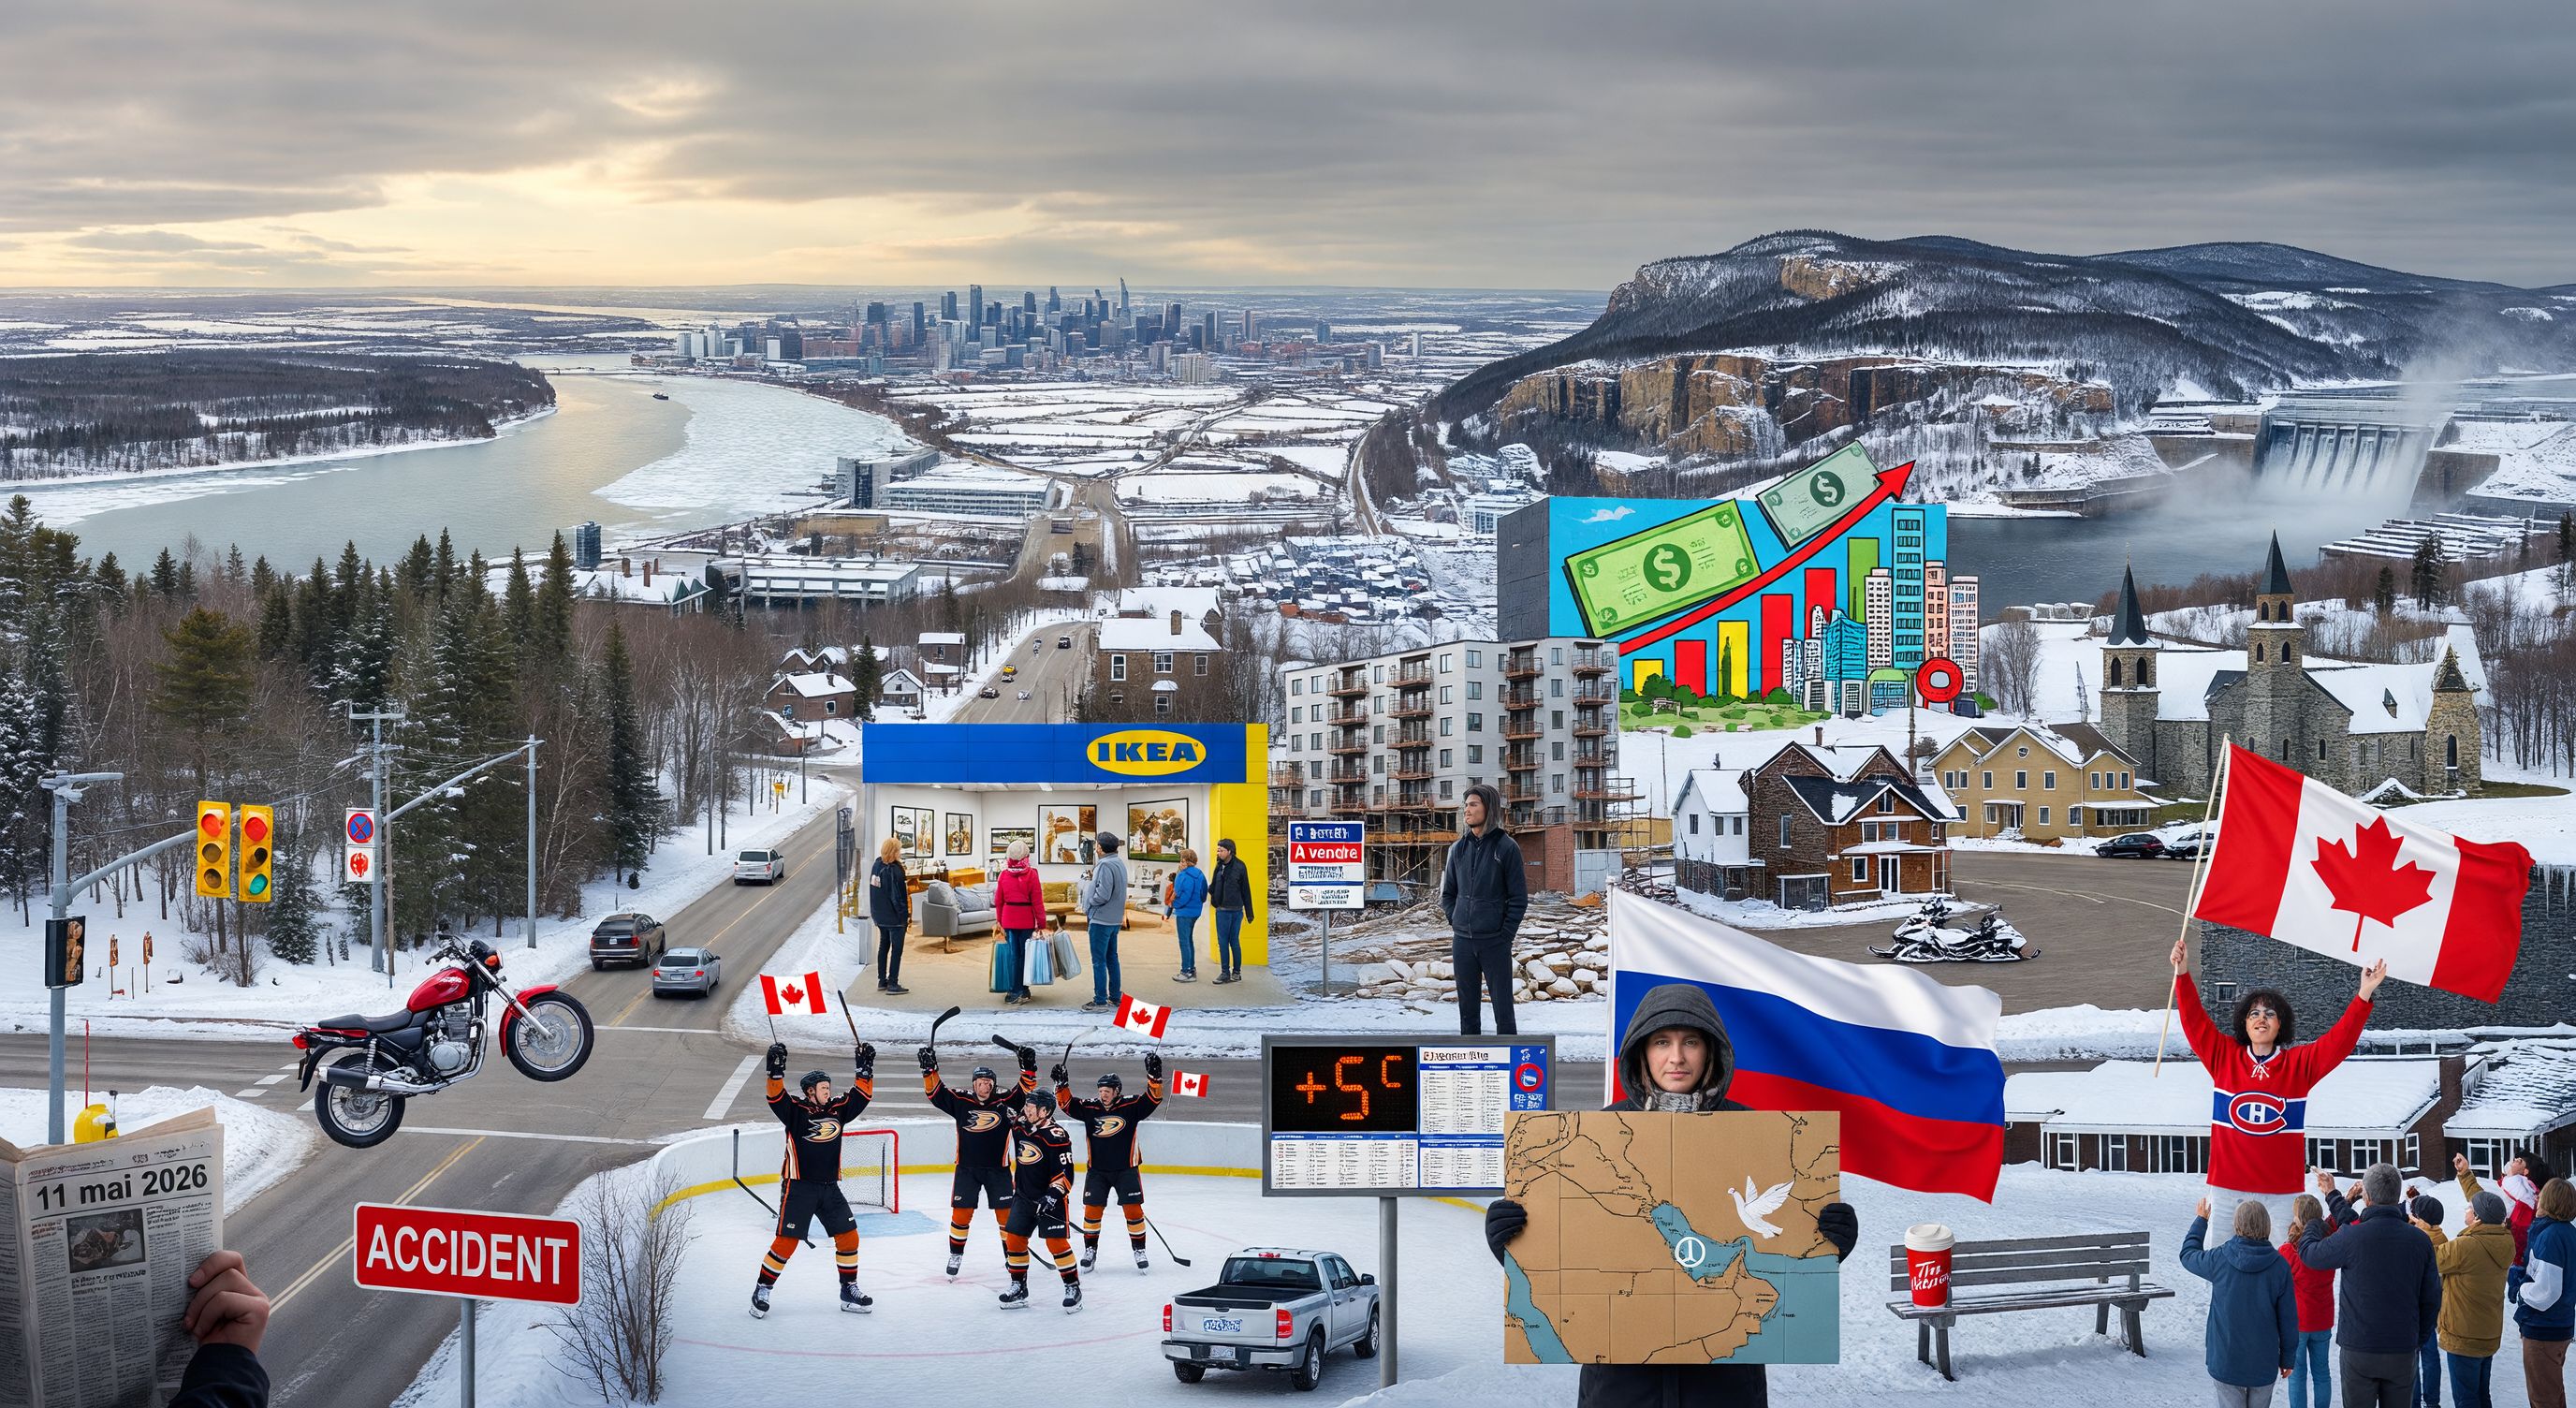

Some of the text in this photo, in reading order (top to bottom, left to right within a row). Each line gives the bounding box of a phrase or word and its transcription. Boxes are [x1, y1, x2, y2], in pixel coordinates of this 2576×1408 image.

[1653, 547, 1681, 589] $
[1097, 742, 1198, 762] IKEA
[1309, 844, 1358, 859] vendre
[37, 1183, 66, 1210] 11
[80, 1173, 132, 1205] mai
[141, 1164, 208, 1196] 2026
[366, 1224, 568, 1284] ACCIDENT
